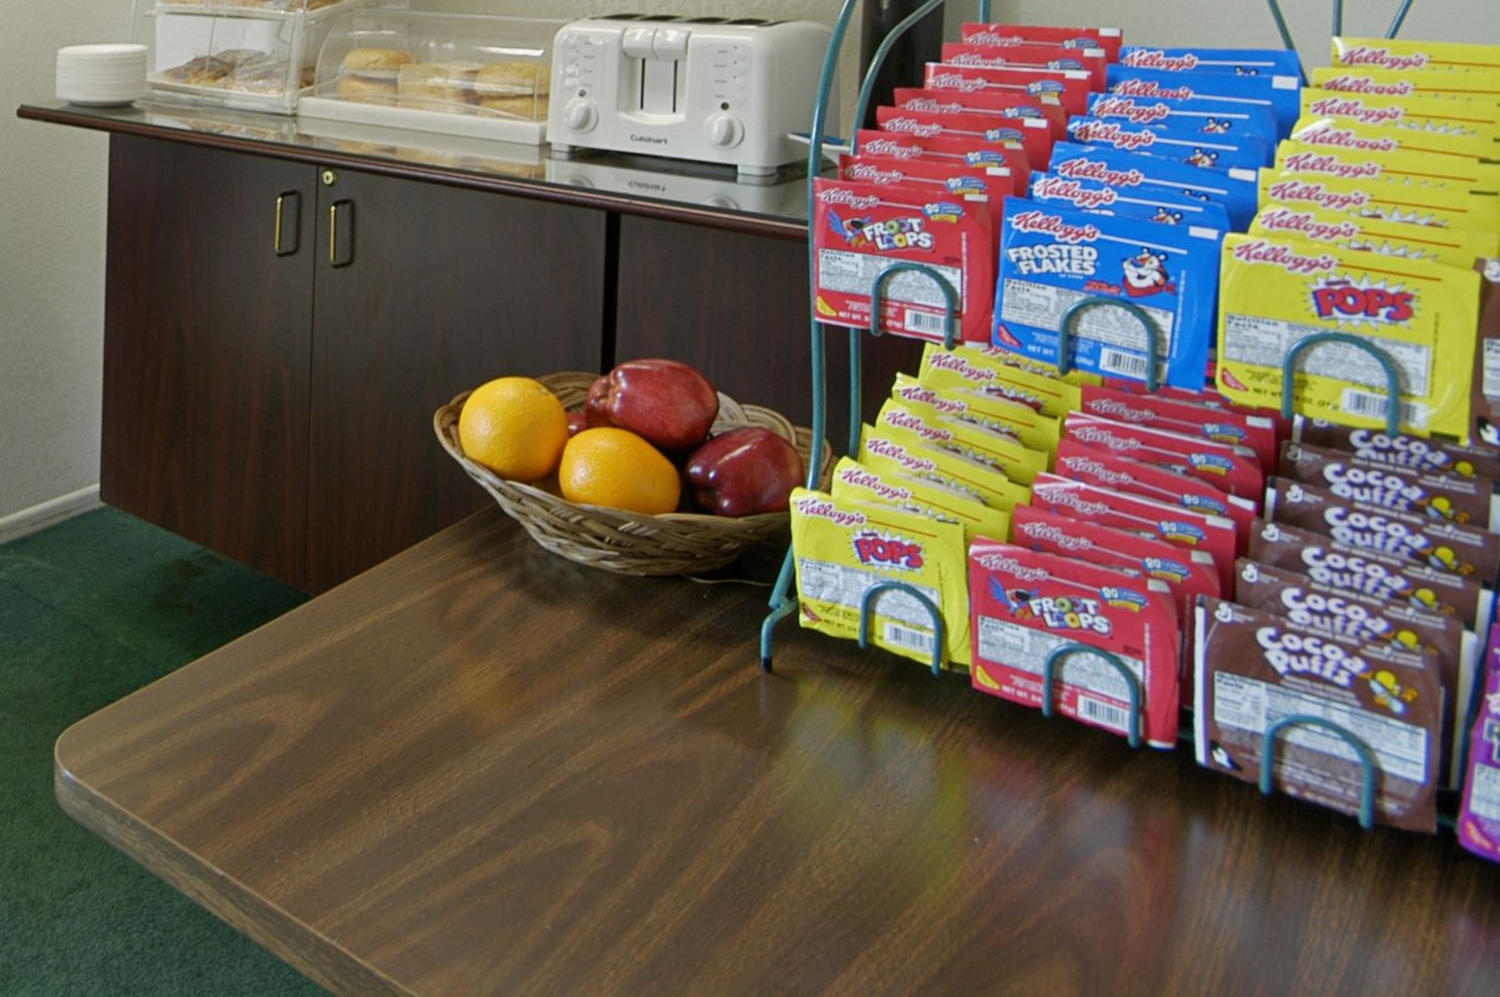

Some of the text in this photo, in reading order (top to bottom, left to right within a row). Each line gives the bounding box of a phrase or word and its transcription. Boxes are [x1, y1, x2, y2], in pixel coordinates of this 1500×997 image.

[1123, 50, 1198, 71] Kellogg's
[1341, 47, 1428, 68] Kellogg's
[931, 73, 988, 93] Kellogg's
[1093, 98, 1170, 122] Kellogg's
[1311, 98, 1403, 123] Kellogg's
[629, 134, 668, 145] Cuisinart
[884, 117, 943, 137] Kellogg's
[1075, 121, 1156, 148] Kellogg's
[864, 139, 923, 159] Kellogg's
[845, 164, 902, 186] Kellogg's
[1057, 157, 1145, 187] Kellogg's
[1285, 153, 1381, 178] Kellogg's
[819, 187, 880, 210] Kellogg's
[1033, 177, 1117, 208] Kellogg's
[1269, 181, 1368, 209] Kellogg's
[863, 217, 924, 242] FROOT
[1012, 210, 1100, 242] Kellogg's
[1260, 210, 1358, 240] Kellogg's
[875, 232, 934, 251] LOOPS
[1008, 243, 1098, 263] FROSTED
[1018, 259, 1097, 276] FLAKES
[1234, 241, 1336, 274] Kellogg's
[1312, 286, 1415, 321] POPS
[930, 353, 996, 381] Kellogg's
[901, 386, 968, 412] Kellogg's
[1089, 397, 1156, 421] Kellogg's
[885, 410, 953, 442] Kellogg's
[1073, 426, 1141, 450] Kellogg's
[866, 437, 936, 472] Kellogg's
[1349, 429, 1449, 465] Cocoa
[1064, 455, 1133, 484] Kellogg's
[1323, 463, 1426, 501] Cocoa
[840, 468, 911, 501] Kellogg's
[1330, 482, 1412, 511] Puffs
[798, 498, 867, 526] Kellogg's
[1023, 521, 1093, 550] Kellogg's
[1323, 506, 1430, 549] Cocoa
[1330, 525, 1416, 558] Puffs
[854, 538, 924, 568] POPS
[979, 553, 1049, 582] Kellogg's
[1301, 546, 1410, 590] Cocoa
[1308, 566, 1396, 600] Puffs
[1028, 597, 1101, 619] FROOT
[1280, 587, 1391, 635] Cocoa
[1043, 612, 1112, 636] LOOPS
[1288, 609, 1375, 642] Puffs
[1256, 626, 1368, 674] Cocoa
[1264, 649, 1352, 688] Puffs
